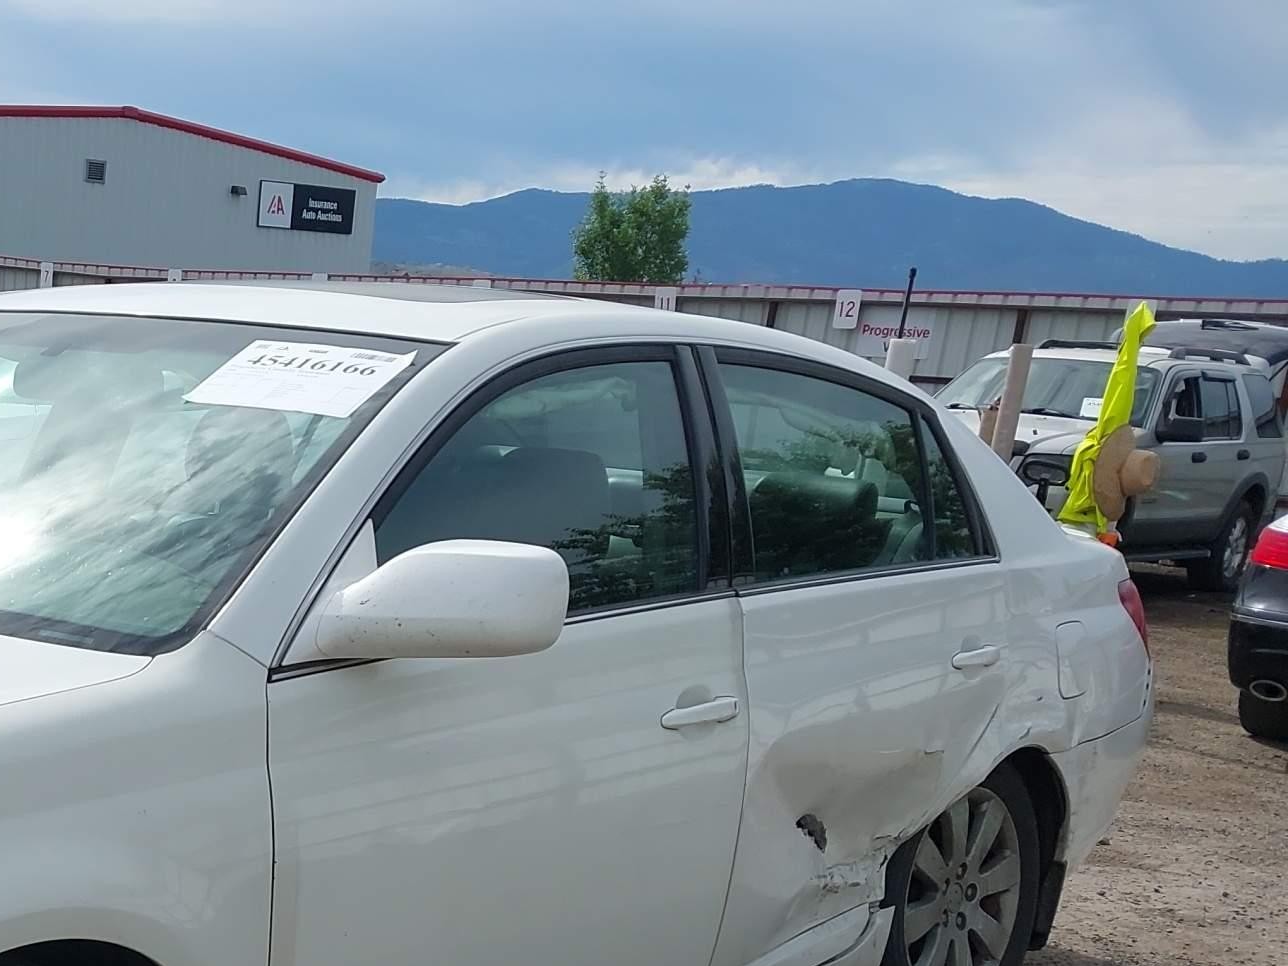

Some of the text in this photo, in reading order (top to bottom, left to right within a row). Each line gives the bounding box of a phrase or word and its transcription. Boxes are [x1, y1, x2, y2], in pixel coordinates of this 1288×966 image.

[308, 197, 338, 209] Insurance
[302, 209, 343, 222] Auto Auctions
[44, 270, 50, 282] 7
[839, 301, 856, 317] 12
[247, 354, 381, 376] 45416166
